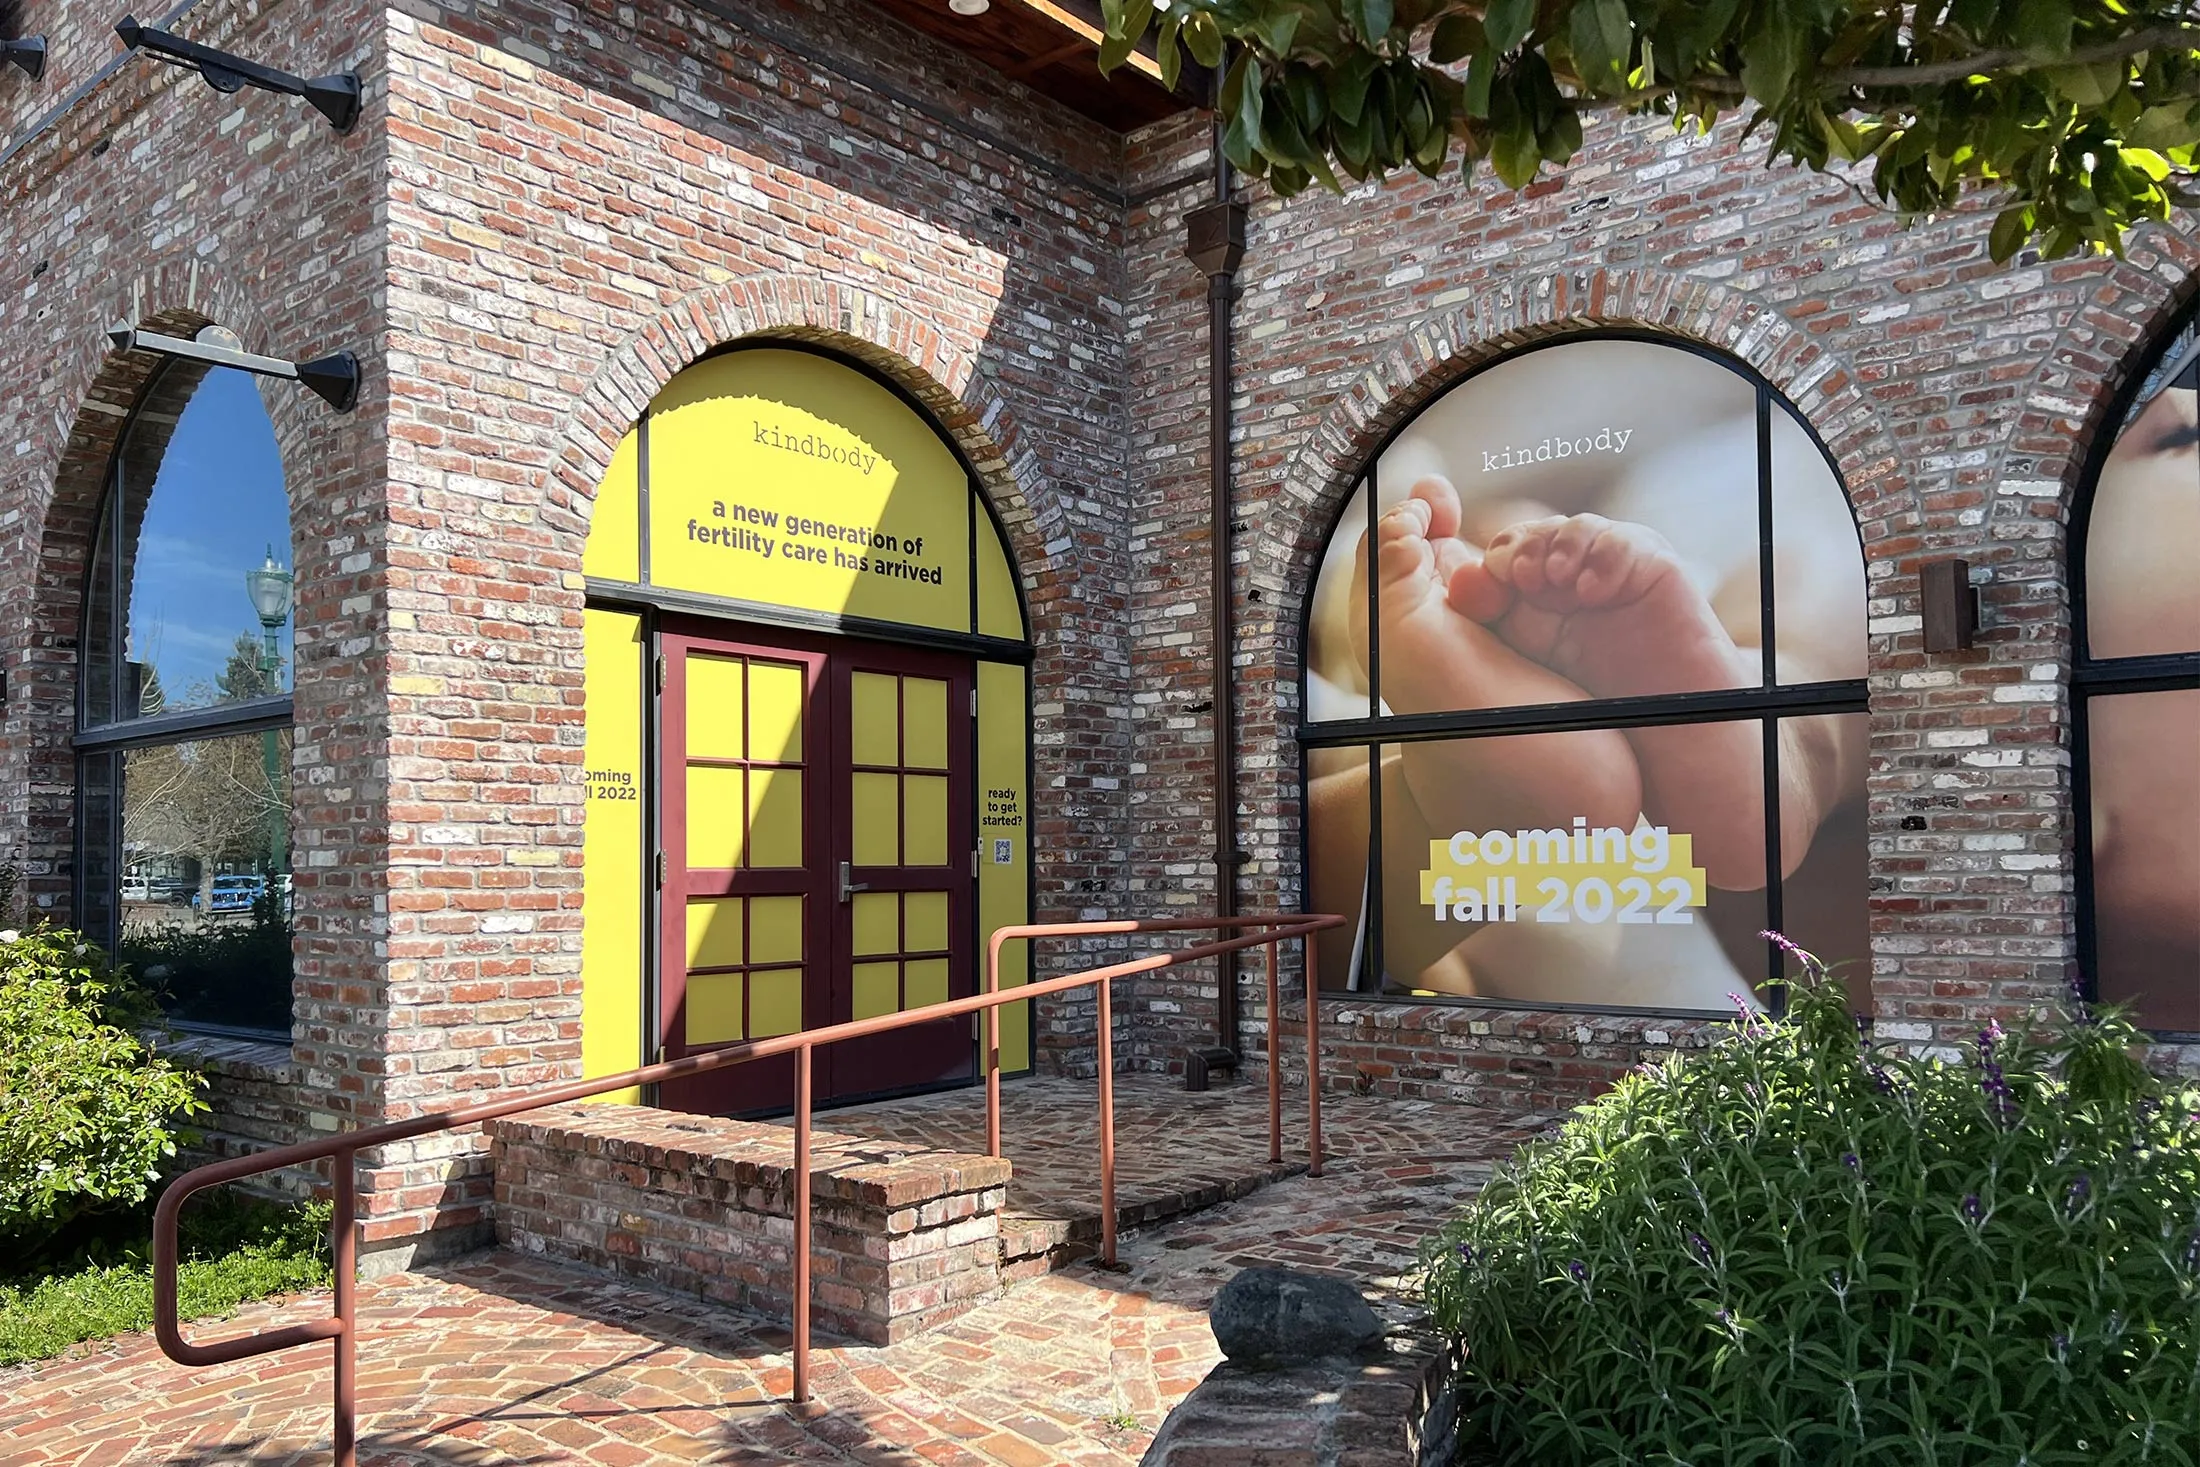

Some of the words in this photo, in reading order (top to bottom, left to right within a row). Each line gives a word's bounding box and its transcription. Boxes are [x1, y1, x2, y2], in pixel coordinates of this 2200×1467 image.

[712, 500, 726, 518] a
[733, 503, 778, 528] new
[785, 515, 897, 552] generation
[903, 537, 923, 556] of
[687, 518, 775, 558] fertility
[782, 541, 827, 564] care
[834, 546, 869, 572] has
[874, 558, 942, 585] arrived
[585, 768, 631, 785] oming
[597, 786, 636, 800] 2022
[988, 787, 1016, 801] ready
[987, 801, 998, 812] to
[1001, 802, 1017, 814] get
[982, 815, 1023, 826] started?
[1449, 816, 1670, 873] coming
[1431, 876, 1517, 922] fall
[1536, 877, 1694, 924] 2022
